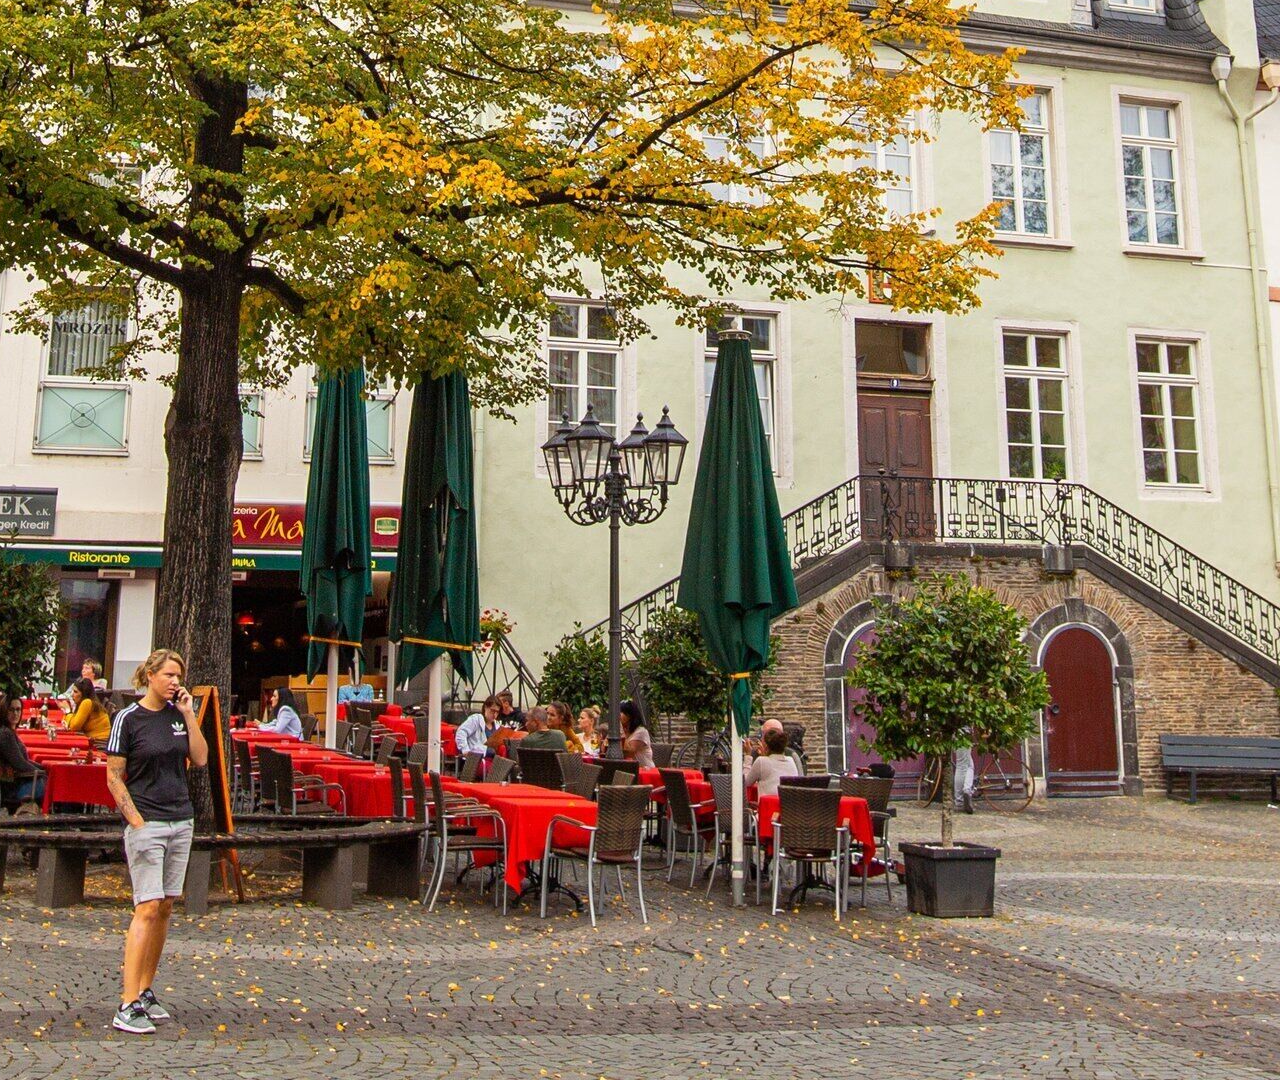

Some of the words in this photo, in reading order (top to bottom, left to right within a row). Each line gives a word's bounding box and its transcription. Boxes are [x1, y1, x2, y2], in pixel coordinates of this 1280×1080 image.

[54, 322, 127, 335] MROZEK
[35, 508, 51, 516] e.K.
[233, 507, 258, 515] zzeria
[20, 520, 50, 530] Kredit
[232, 518, 247, 539] a
[69, 551, 131, 563] Ristorante
[232, 557, 257, 568] mma
